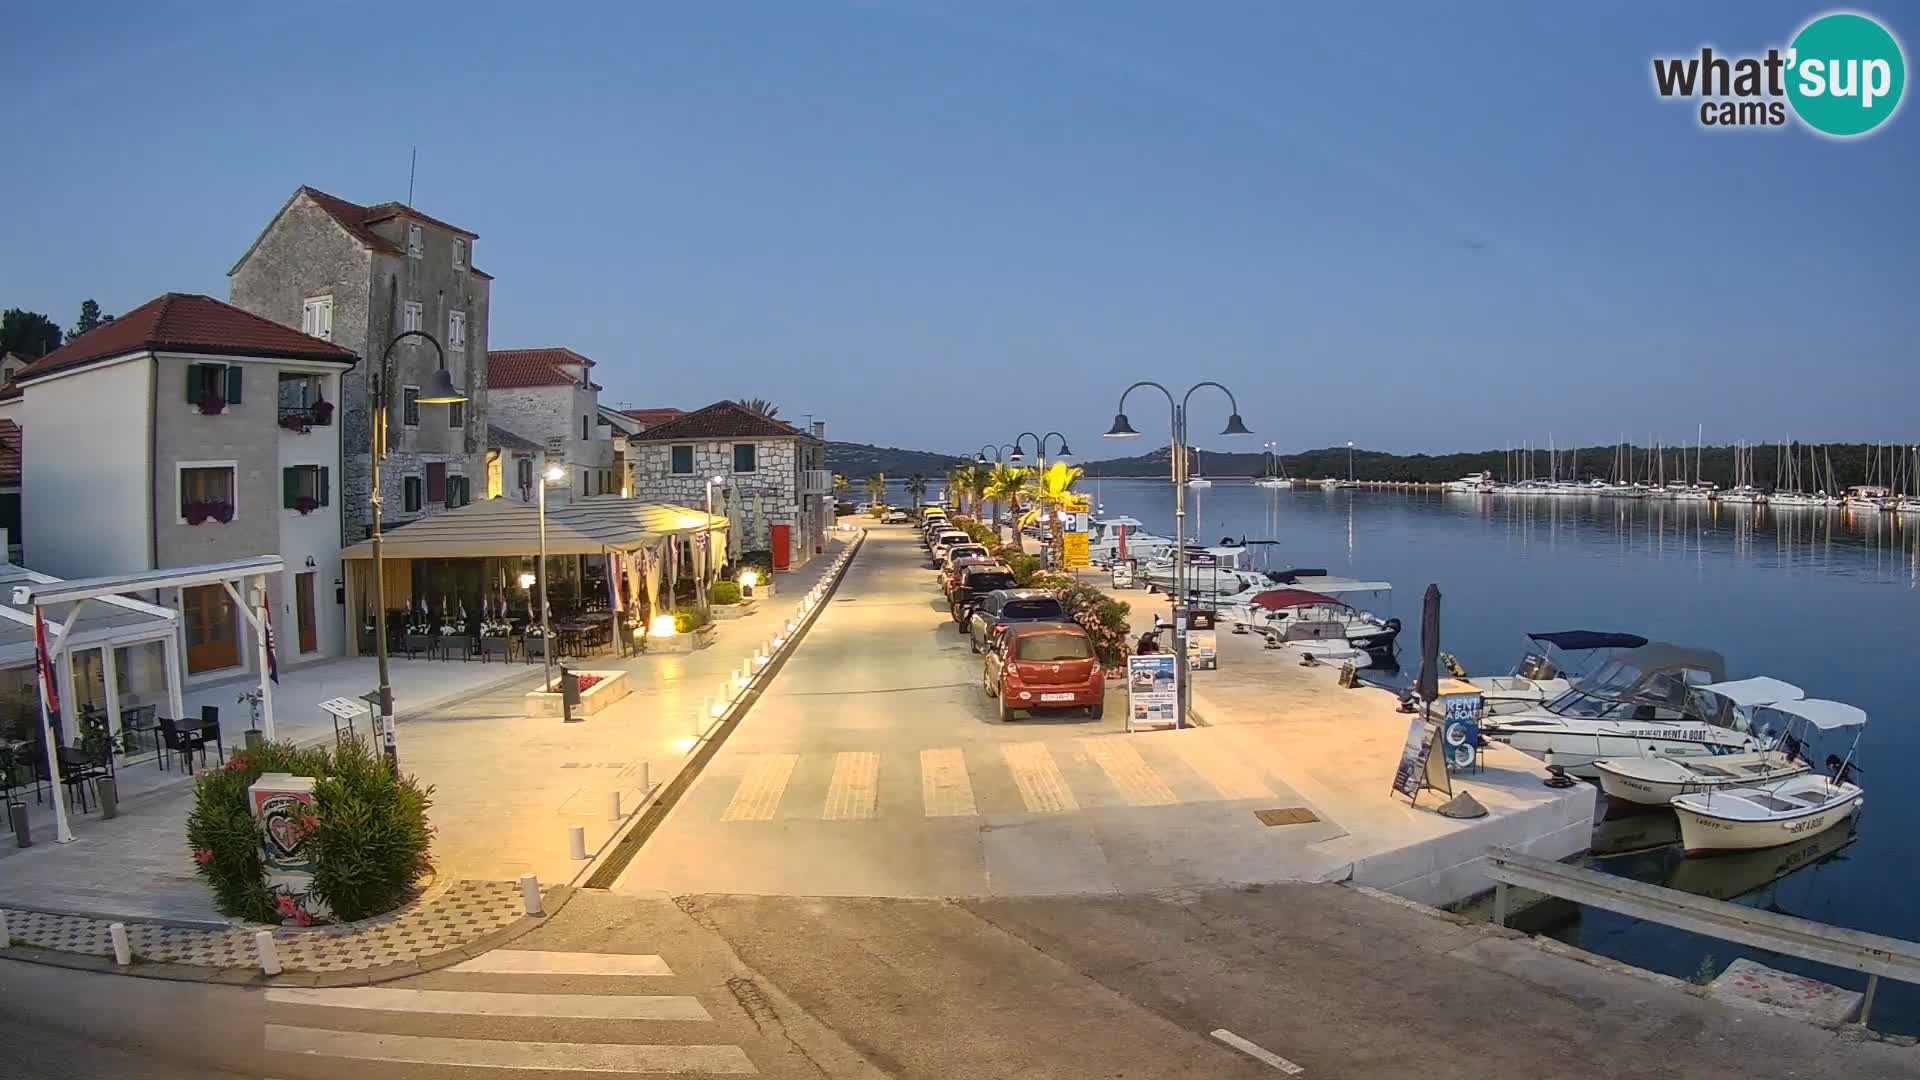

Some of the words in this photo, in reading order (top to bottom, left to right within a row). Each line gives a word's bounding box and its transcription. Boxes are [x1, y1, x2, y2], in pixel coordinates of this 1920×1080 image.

[1065, 514, 1075, 531] P
[1447, 699, 1480, 711] RENT
[1446, 711, 1453, 719] A
[1455, 710, 1479, 719] BOAT
[1663, 729, 1682, 739] RENT
[1682, 730, 1687, 739] A
[1689, 730, 1707, 740] BOAT
